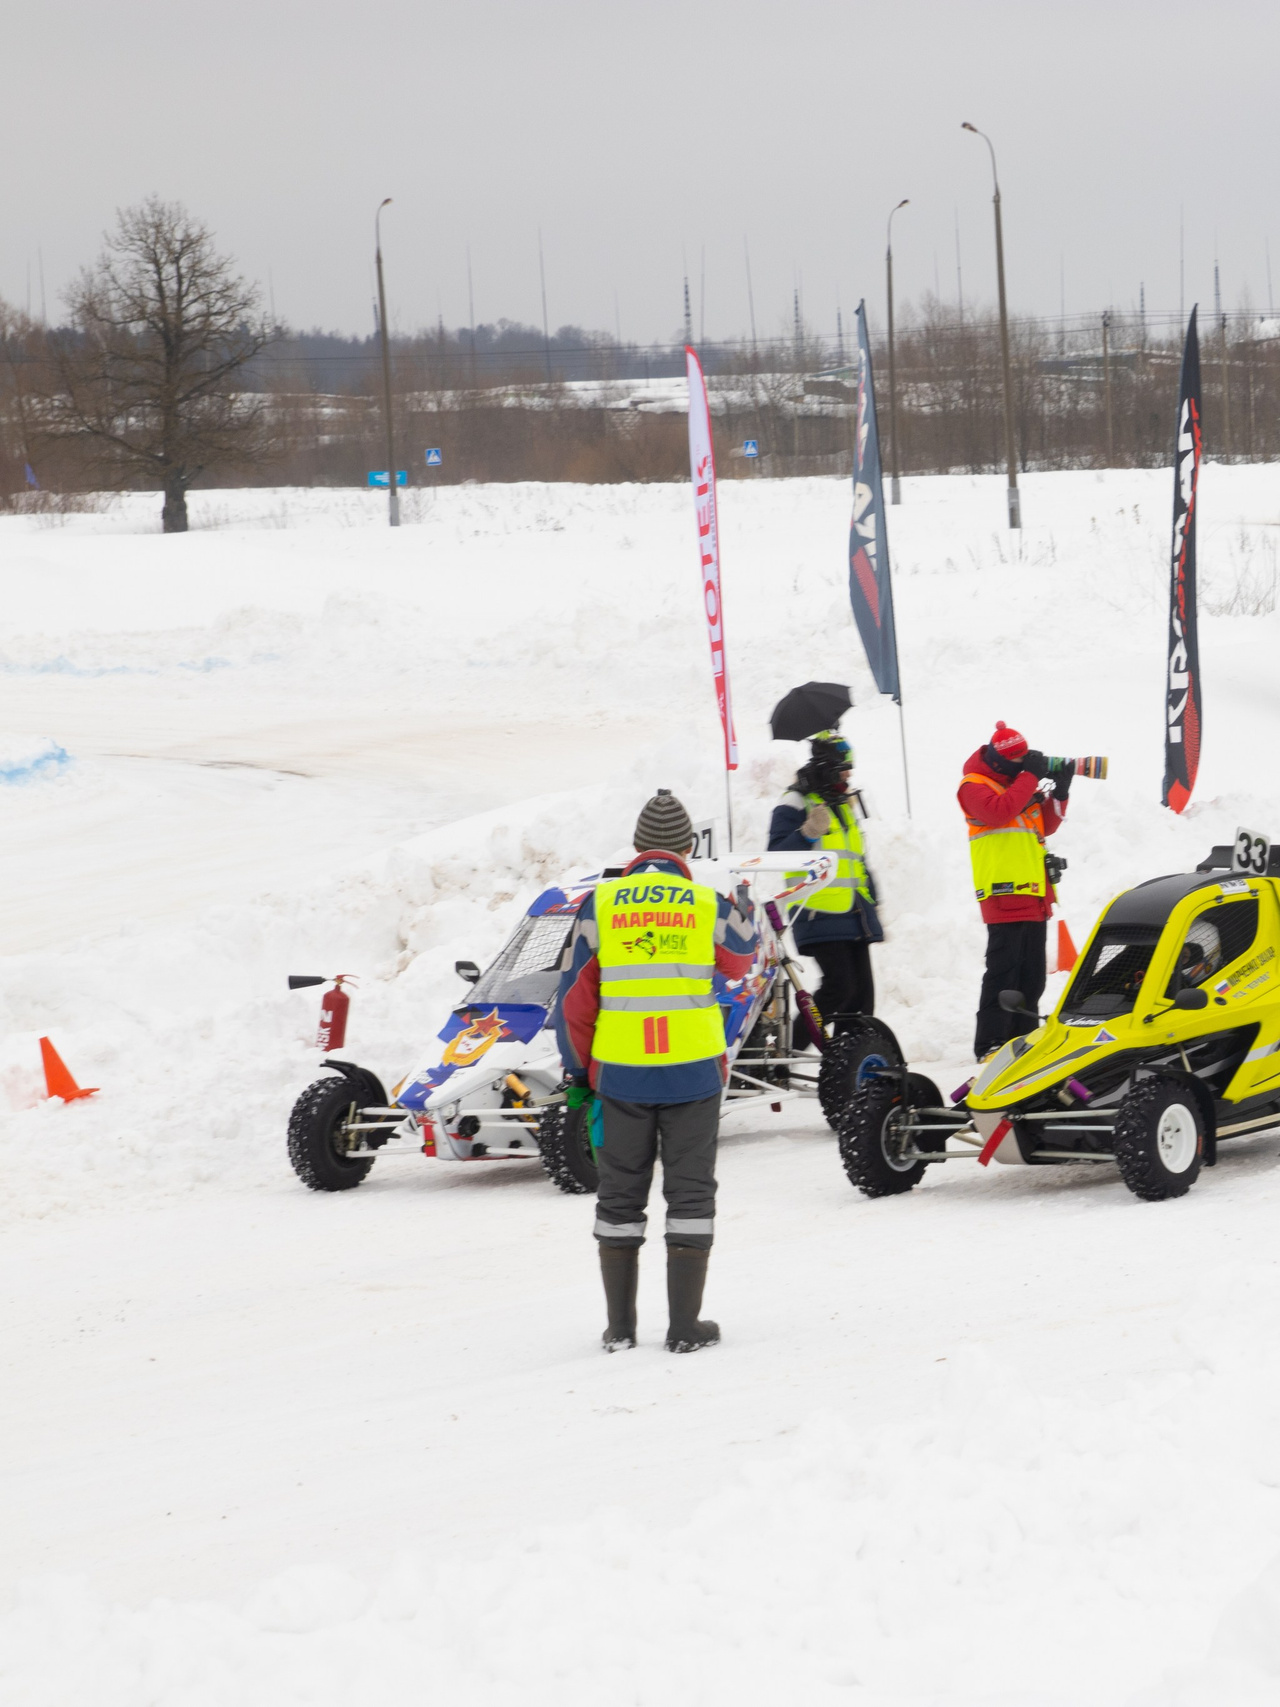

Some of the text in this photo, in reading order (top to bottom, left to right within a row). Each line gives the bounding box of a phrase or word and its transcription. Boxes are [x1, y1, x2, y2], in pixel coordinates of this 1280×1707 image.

[692, 828, 713, 860] 27
[1236, 832, 1268, 874] 33
[613, 885, 695, 906] RUSTA
[611, 912, 696, 929] МАРШАЛ
[659, 934, 688, 951] MSK
